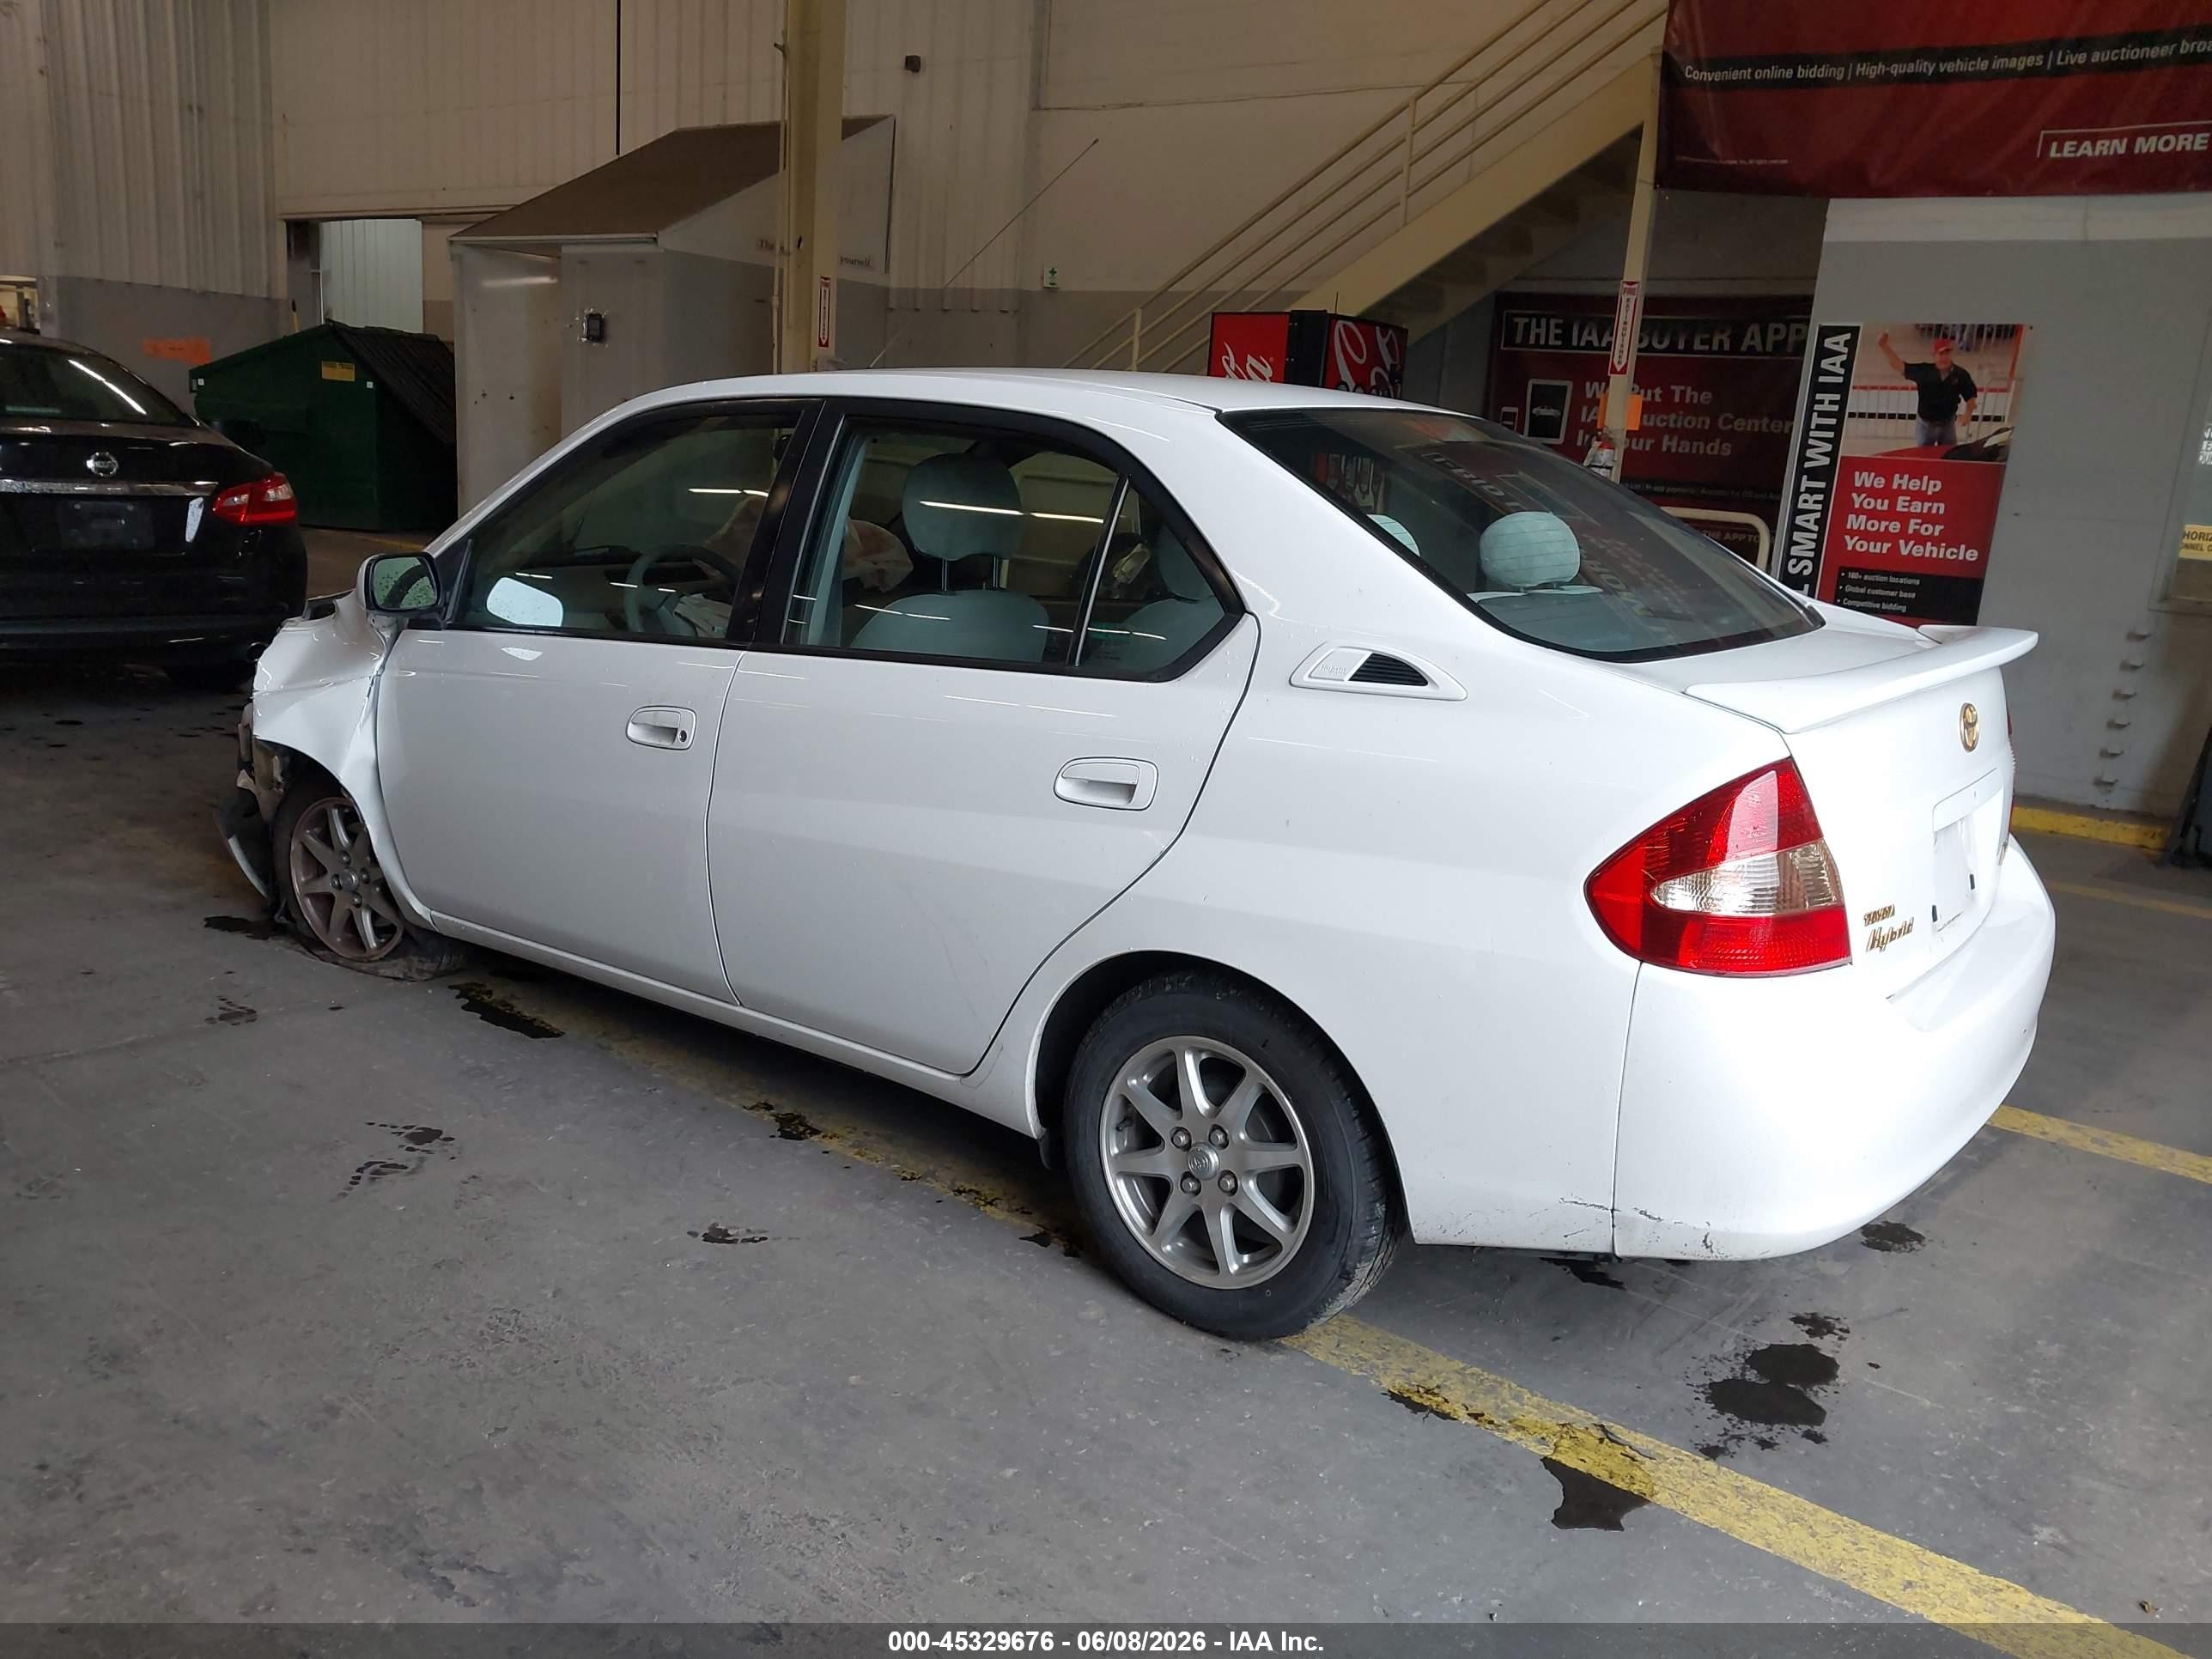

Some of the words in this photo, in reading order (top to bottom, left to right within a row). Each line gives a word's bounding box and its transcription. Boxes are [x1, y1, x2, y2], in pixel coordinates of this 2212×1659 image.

[1685, 65, 1751, 82] Convenient
[1754, 66, 1793, 79] online
[1797, 64, 1845, 80] bidding
[1856, 58, 1936, 79] High-quality
[1939, 57, 1989, 73] vehicle
[1991, 52, 2044, 70] images
[2057, 49, 2087, 65] Live
[2091, 43, 2177, 63] auctioneer
[2050, 137, 2128, 158] LEARN
[2134, 132, 2212, 154] MORE
[1513, 317, 1564, 345] THE
[1741, 322, 1808, 352] APP
[1819, 332, 1852, 384] IAA
[1671, 386, 1712, 404] The
[1642, 411, 1710, 429] uction
[1718, 413, 1794, 434] Center
[1803, 393, 1841, 468] WITH
[1662, 434, 1732, 456] Hands
[1854, 471, 1886, 488] We
[1892, 473, 1942, 494] Help
[1851, 493, 1889, 510] You
[1896, 495, 1946, 515] Earn
[1788, 475, 1827, 575] SMART
[1846, 514, 1900, 533] More
[1908, 518, 1945, 537] For
[1844, 536, 1892, 554] Your
[1899, 539, 1978, 562] Vehicle
[1866, 916, 1914, 952] Hybrid
